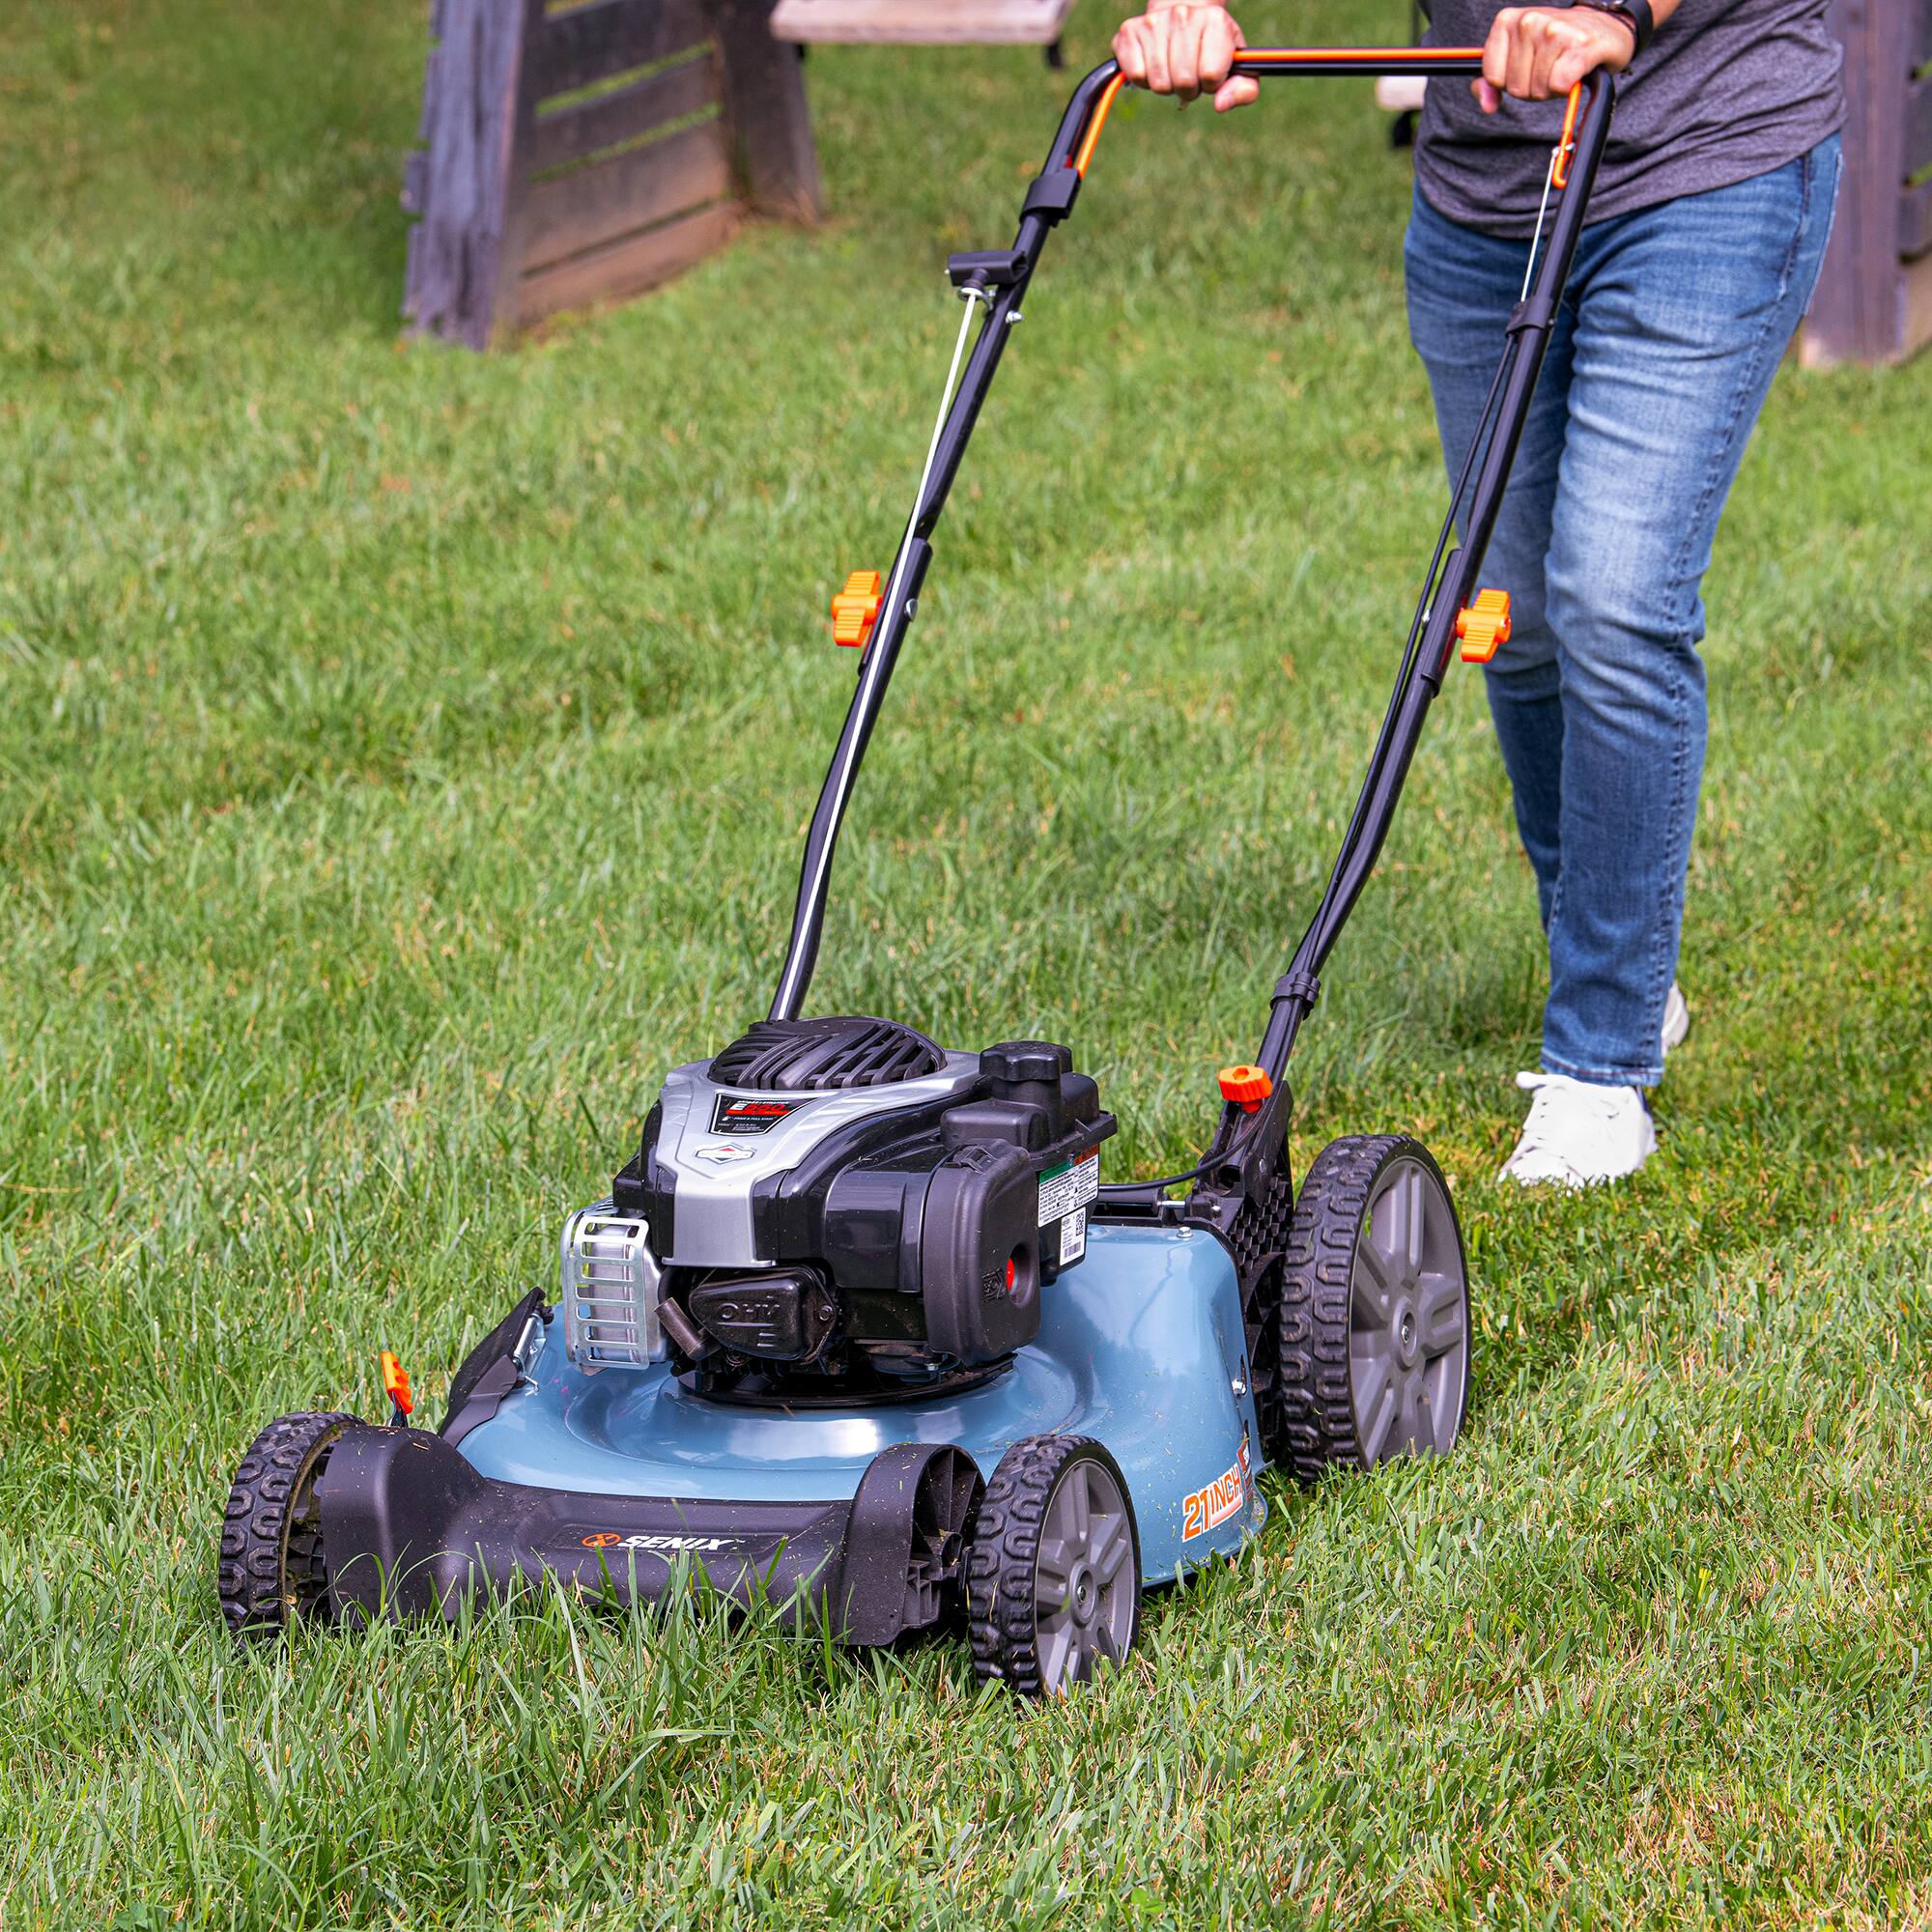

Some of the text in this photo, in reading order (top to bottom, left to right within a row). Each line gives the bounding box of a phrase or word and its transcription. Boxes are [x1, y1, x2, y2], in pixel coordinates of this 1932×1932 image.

[1183, 1489, 1209, 1540] 21
[1209, 1465, 1242, 1515] INCH
[617, 1535, 734, 1550] SENIX
